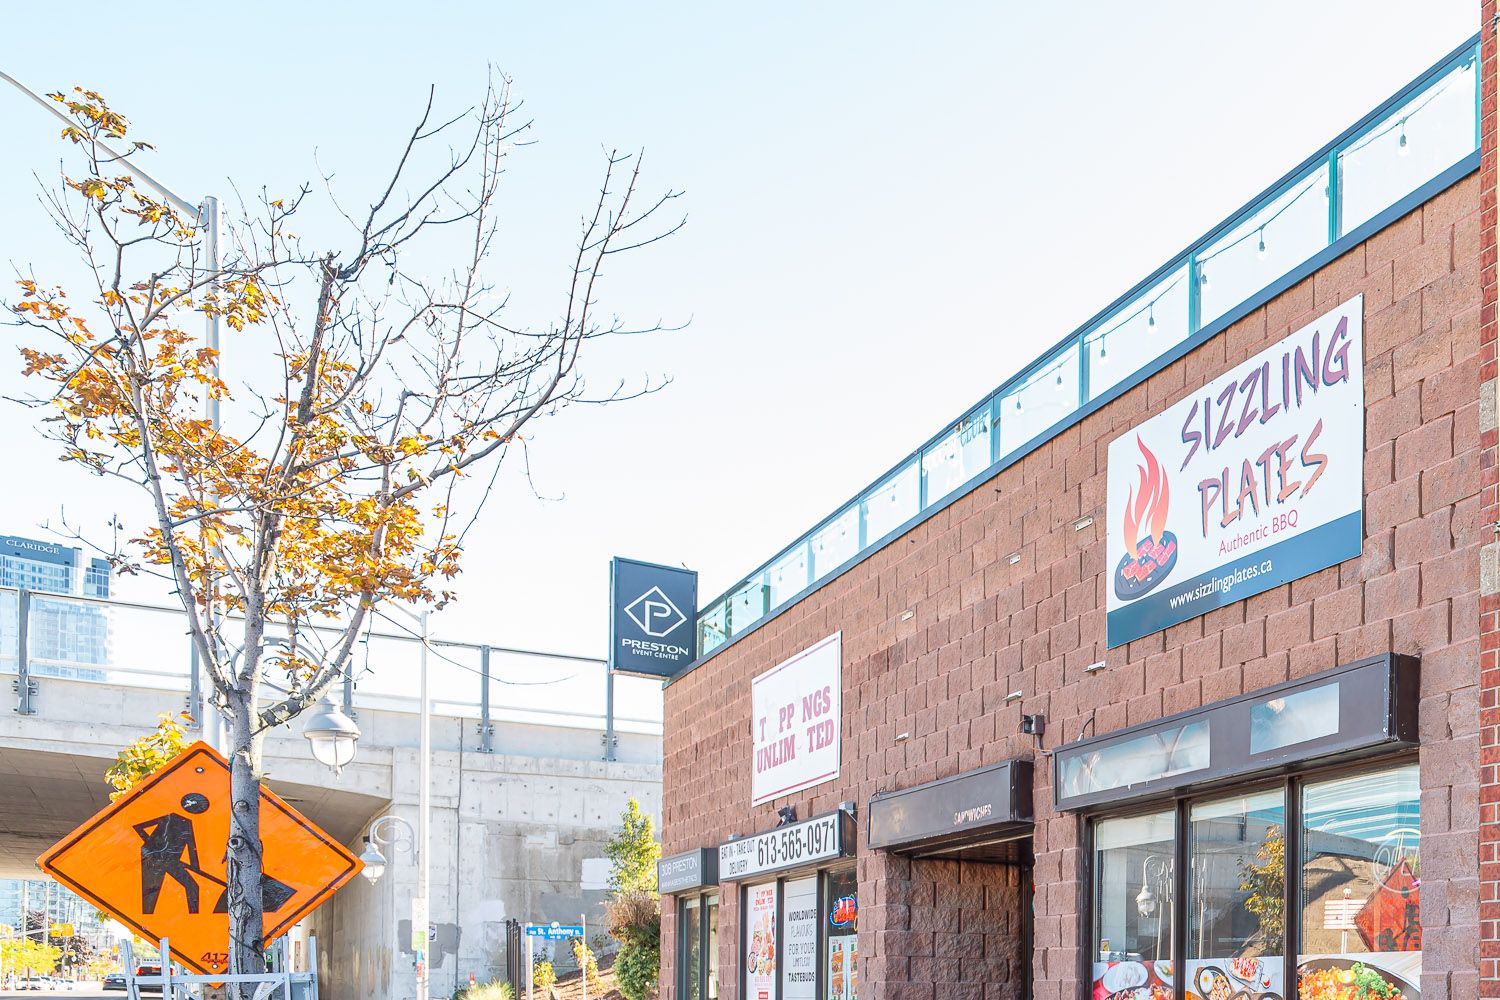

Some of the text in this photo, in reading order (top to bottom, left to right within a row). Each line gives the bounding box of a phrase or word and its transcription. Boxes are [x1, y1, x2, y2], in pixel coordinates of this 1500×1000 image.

[1180, 316, 1352, 472] SIZZLING
[1198, 418, 1328, 538] PLATES
[6, 539, 60, 555] CLARIDGE
[1219, 509, 1299, 556] Authentic BBQ
[1169, 558, 1273, 610] www.sizzlingplates.ca
[622, 638, 689, 656] PRESTON
[632, 648, 679, 661] EVENT CENTRE
[760, 685, 831, 742] TPPNGS
[757, 718, 834, 774] UNLIMTED
[758, 819, 836, 867] 613-565-0971
[788, 908, 817, 922] WORLDWIDE
[548, 927, 574, 937] Anthony
[789, 941, 815, 955] FOR YOUR
[788, 971, 815, 983] TASTEBUDS
